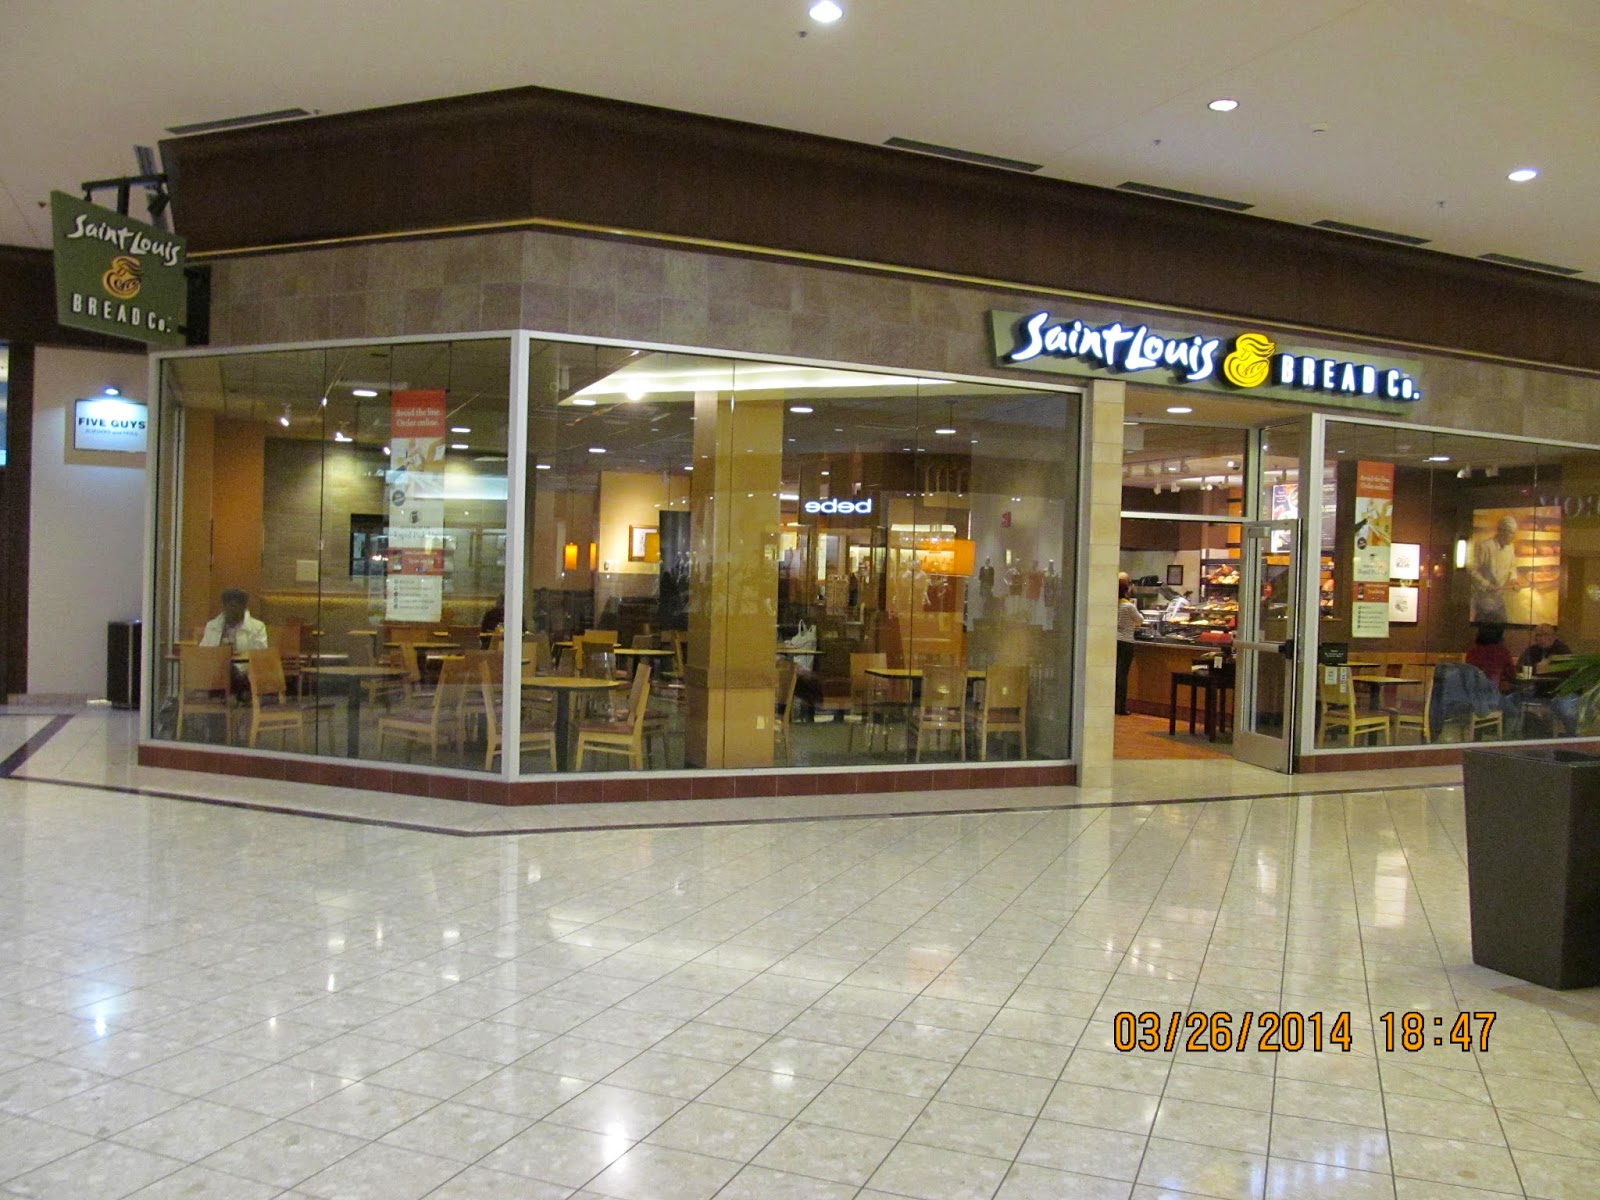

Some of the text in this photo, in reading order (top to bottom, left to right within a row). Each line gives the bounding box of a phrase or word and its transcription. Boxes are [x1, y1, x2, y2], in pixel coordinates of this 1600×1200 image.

[67, 214, 182, 266] Saint Louis
[72, 293, 171, 333] BREAD Co.
[1010, 311, 1421, 400] Saint Louis BREAD Co.
[78, 417, 146, 430] FIVE GUYS
